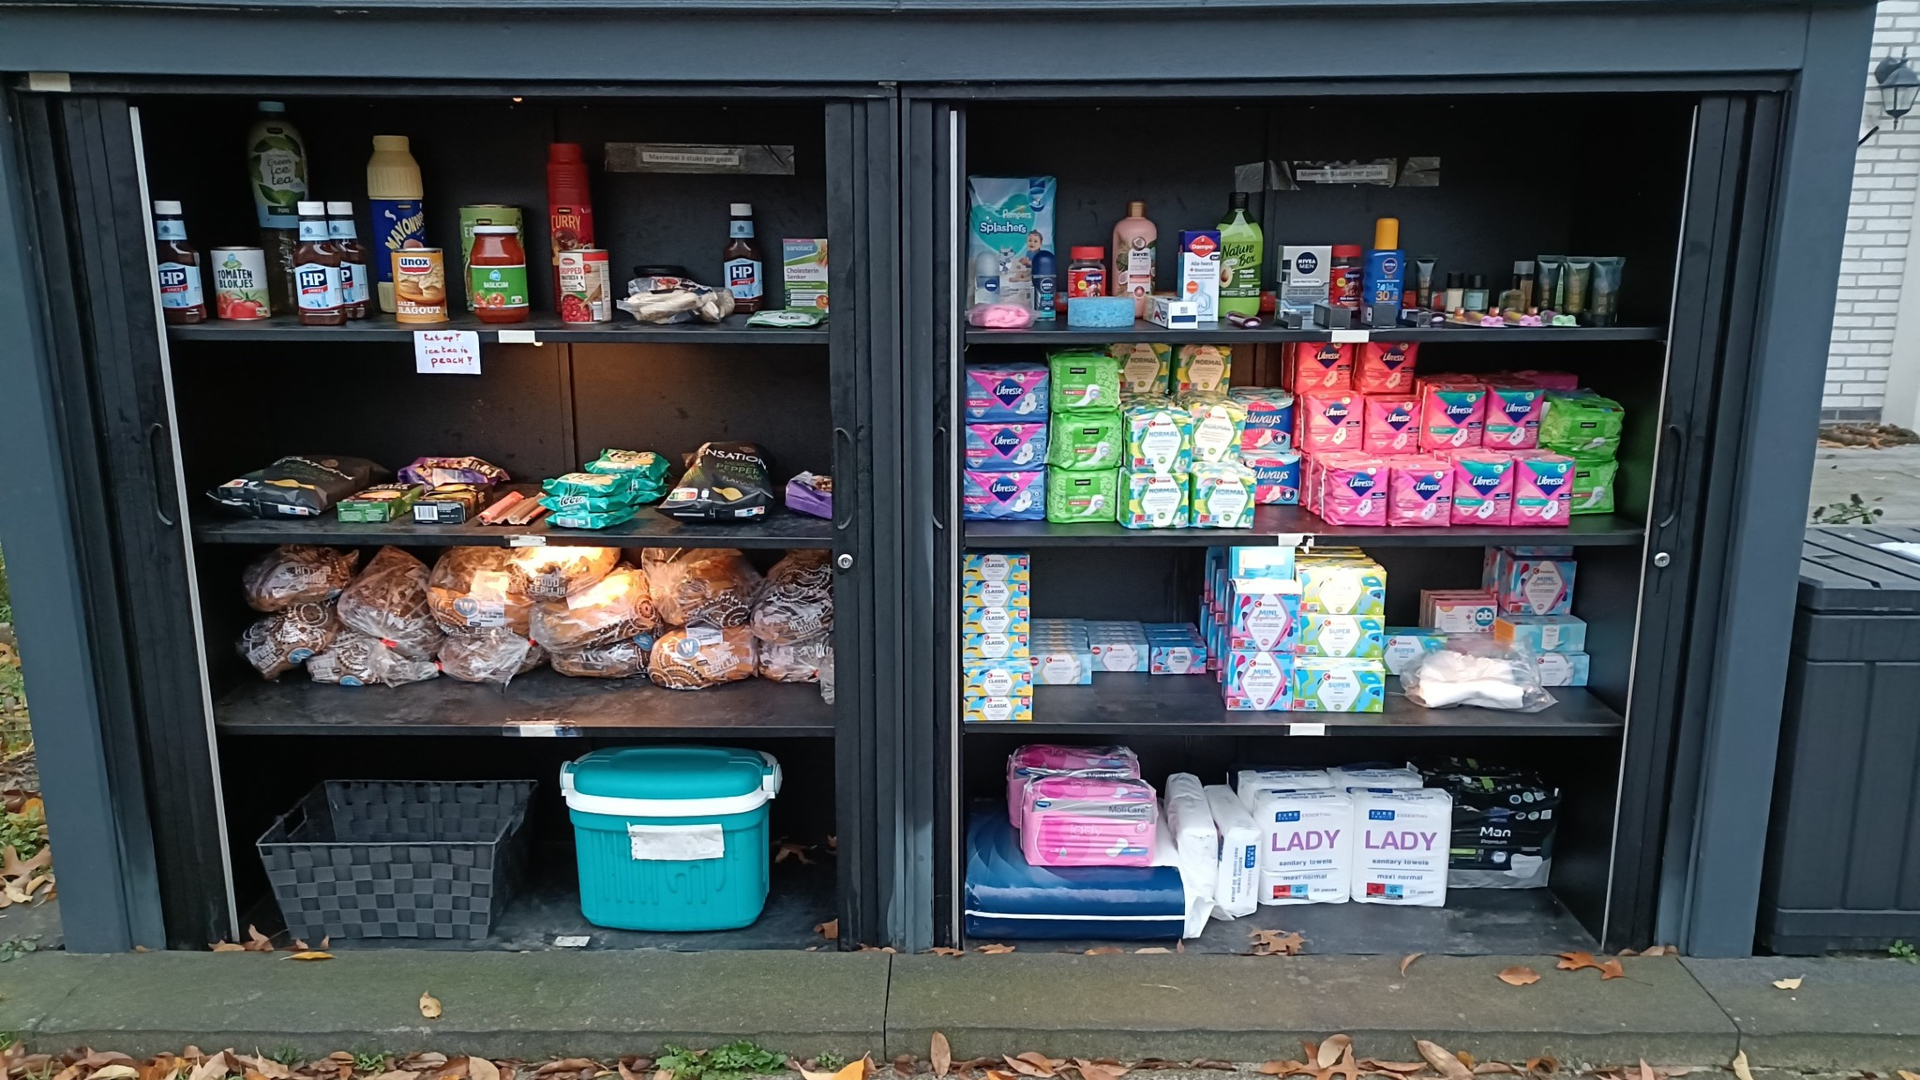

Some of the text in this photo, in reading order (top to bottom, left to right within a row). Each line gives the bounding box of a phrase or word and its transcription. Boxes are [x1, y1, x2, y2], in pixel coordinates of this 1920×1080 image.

[271, 175, 294, 186] tea
[1002, 208, 1032, 220] Pampers
[551, 215, 581, 232] CURRY
[980, 221, 1027, 234] Splashers
[1191, 244, 1215, 252] Dampo
[1222, 244, 1255, 261] Nature
[1238, 254, 1257, 268] Box
[217, 269, 253, 279] TOMATEN
[732, 266, 753, 279] HP
[786, 267, 820, 275] Cholesterin
[160, 272, 184, 285] HP
[219, 279, 254, 289] BLOKJES
[301, 273, 325, 286] HP
[1376, 290, 1390, 302] 30
[398, 306, 441, 315] RAGOUT
[996, 384, 1023, 396] Libresse
[1447, 405, 1474, 415] Libresse
[1505, 403, 1532, 413] Libresse
[994, 435, 1020, 445] Libresse
[705, 448, 767, 470] NSATION
[1349, 477, 1375, 488] Libresse
[1472, 475, 1500, 486] Libresse
[1536, 474, 1565, 485] Libresse
[992, 482, 1018, 493] Libresse
[1415, 483, 1441, 491] Libresse
[461, 601, 472, 611] W
[1259, 609, 1277, 617] MINI
[681, 641, 694, 654] W
[1108, 806, 1146, 814] MoliCare
[1479, 826, 1511, 837] Man
[1272, 830, 1340, 851] LADY
[1365, 831, 1437, 850] LADY
